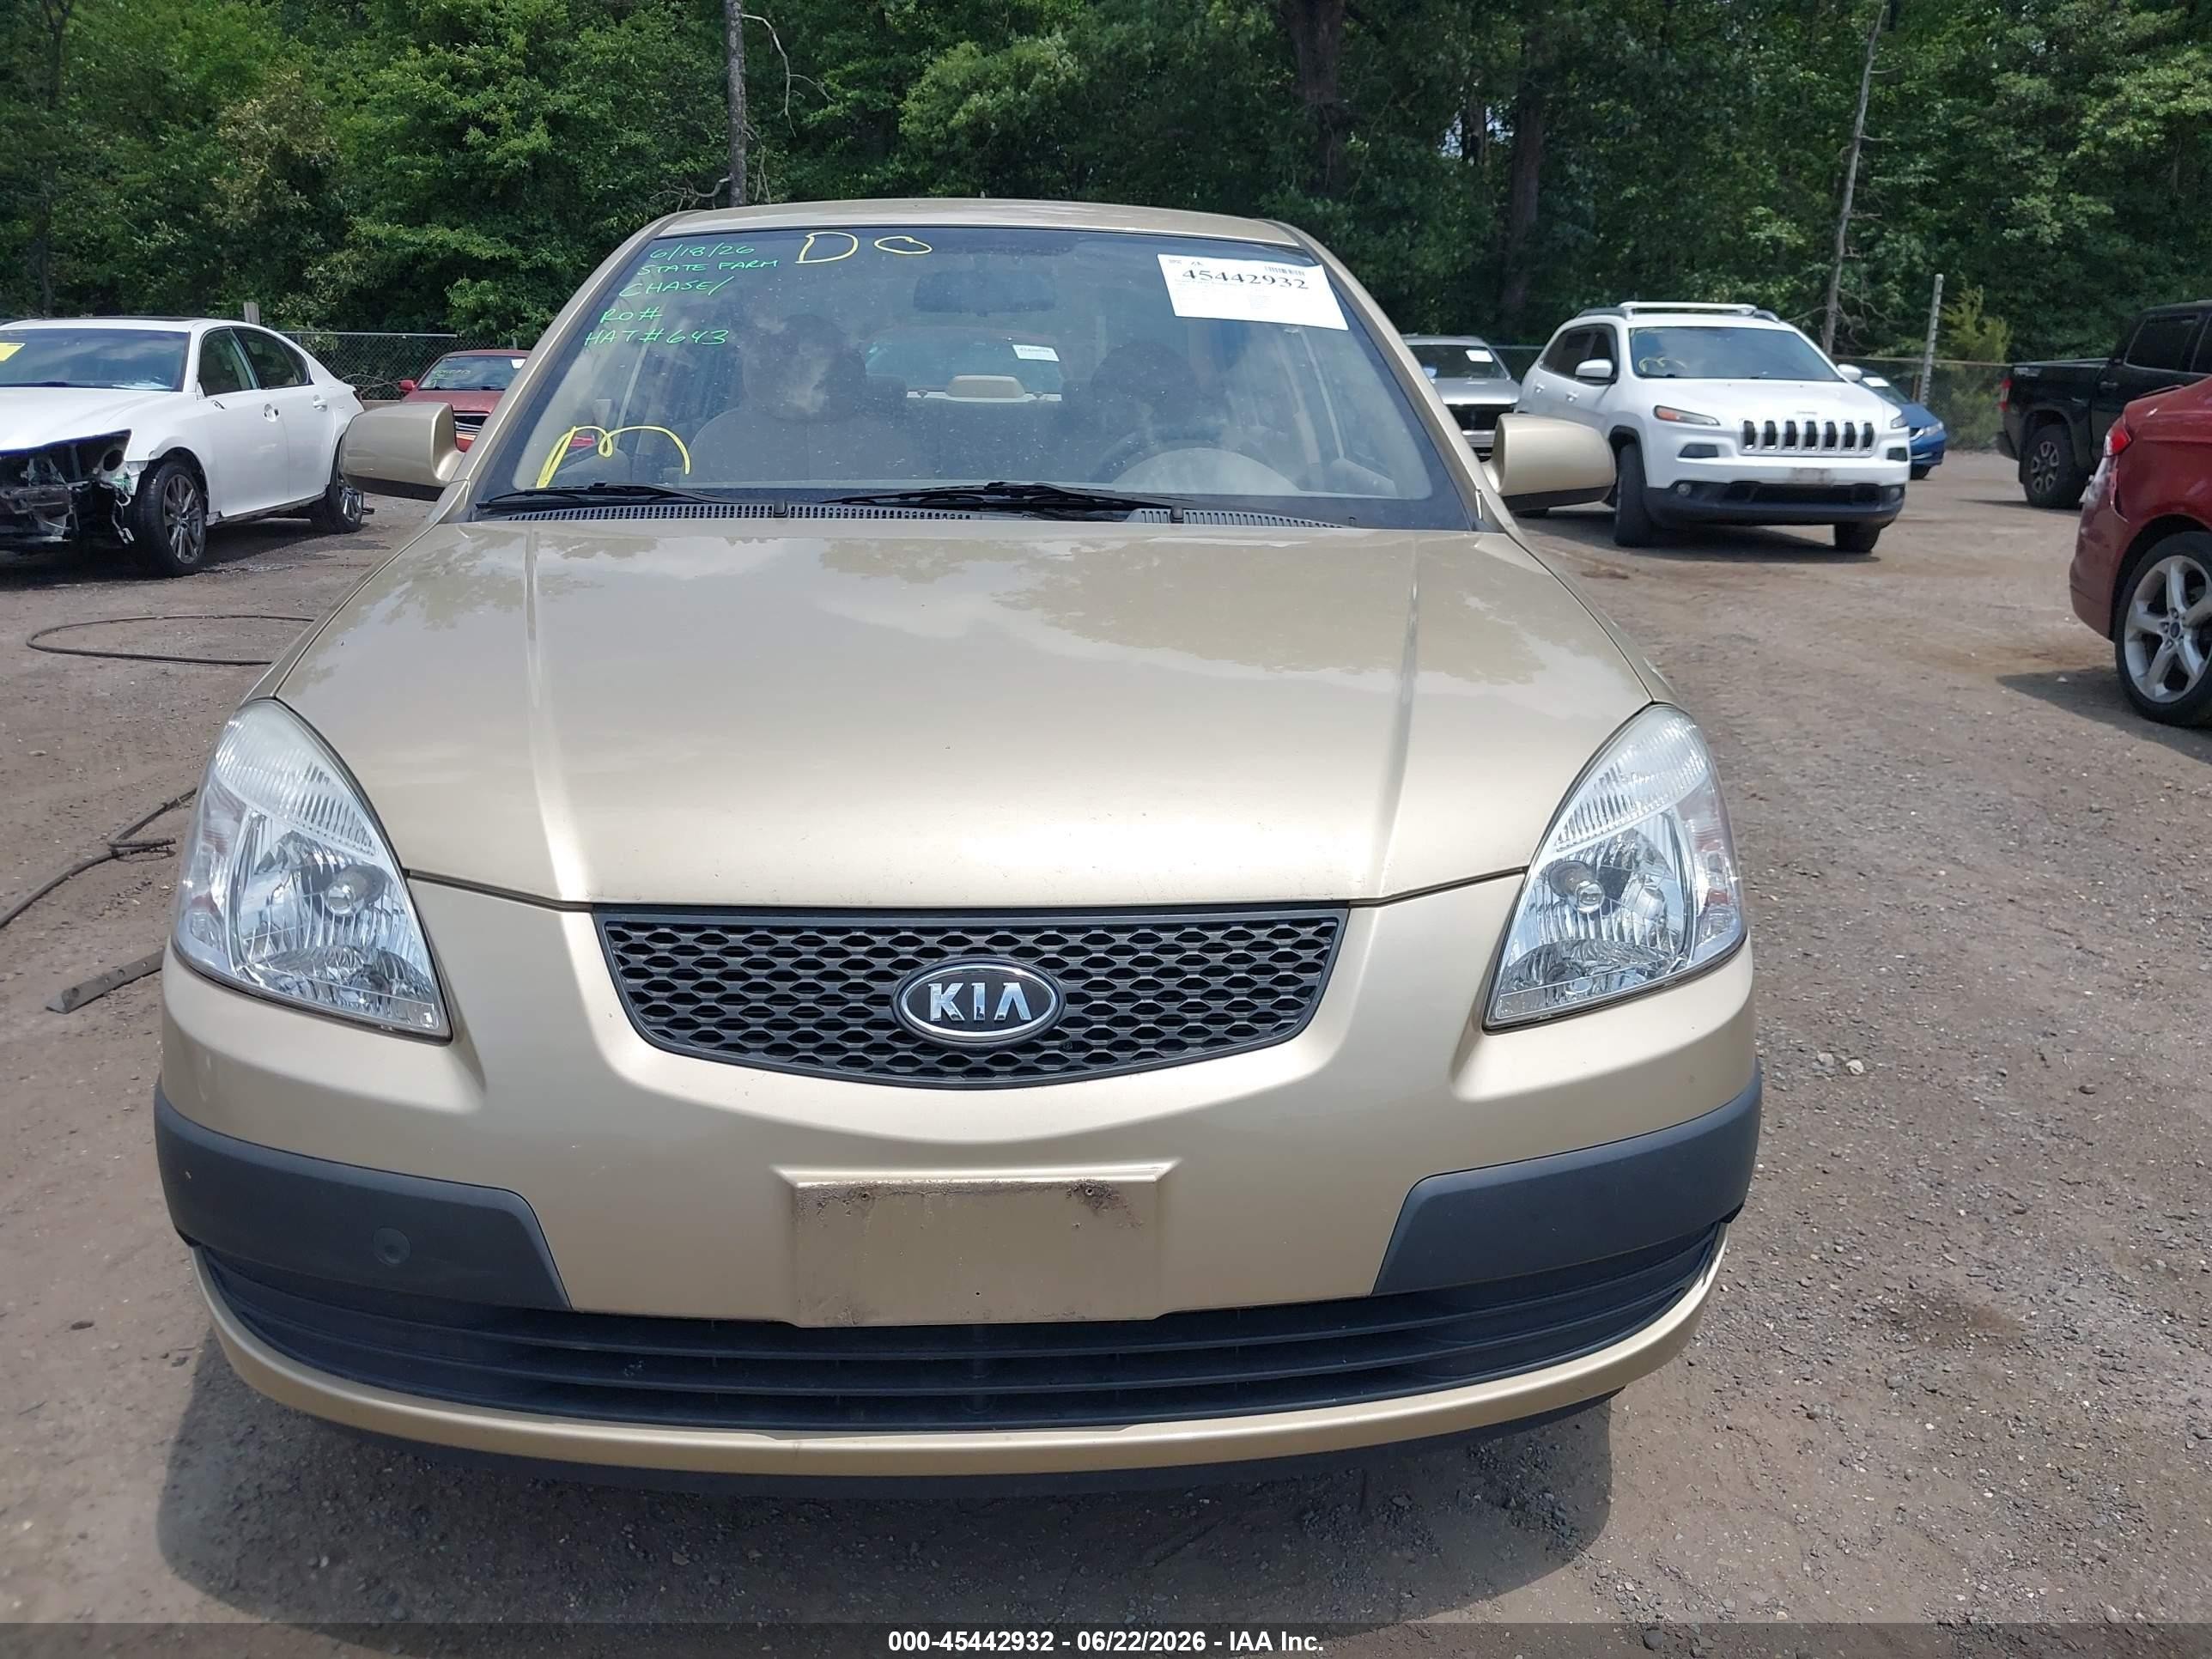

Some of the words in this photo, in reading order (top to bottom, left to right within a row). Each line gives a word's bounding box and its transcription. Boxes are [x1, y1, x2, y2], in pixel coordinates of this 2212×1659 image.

[636, 261, 707, 276] STATE
[718, 259, 779, 271] FARM
[1182, 269, 1310, 290] 45442932
[927, 981, 1033, 1022] KIA
